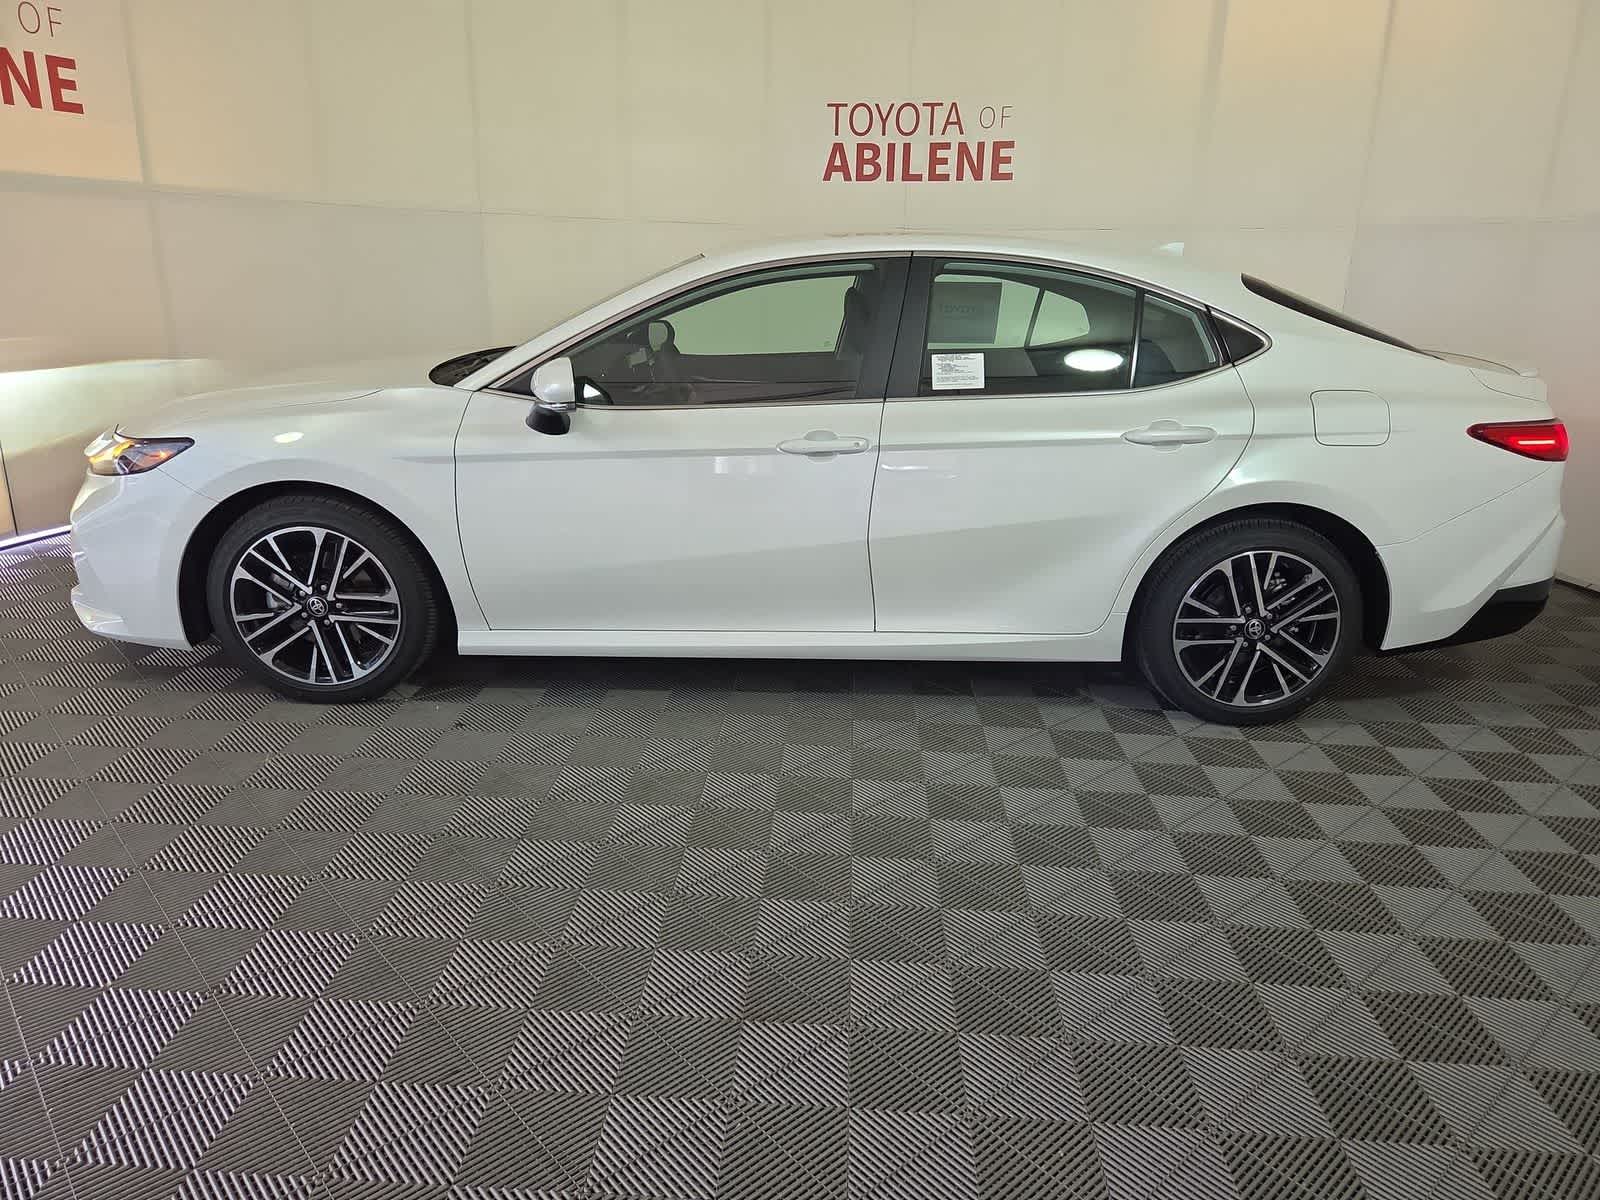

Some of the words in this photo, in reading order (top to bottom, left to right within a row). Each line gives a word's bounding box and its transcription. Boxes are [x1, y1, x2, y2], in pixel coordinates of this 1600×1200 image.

[18, 1, 61, 37] OF
[827, 102, 964, 136] TOYOTA
[979, 105, 1013, 129] OF
[822, 140, 1015, 182] ABILENE
